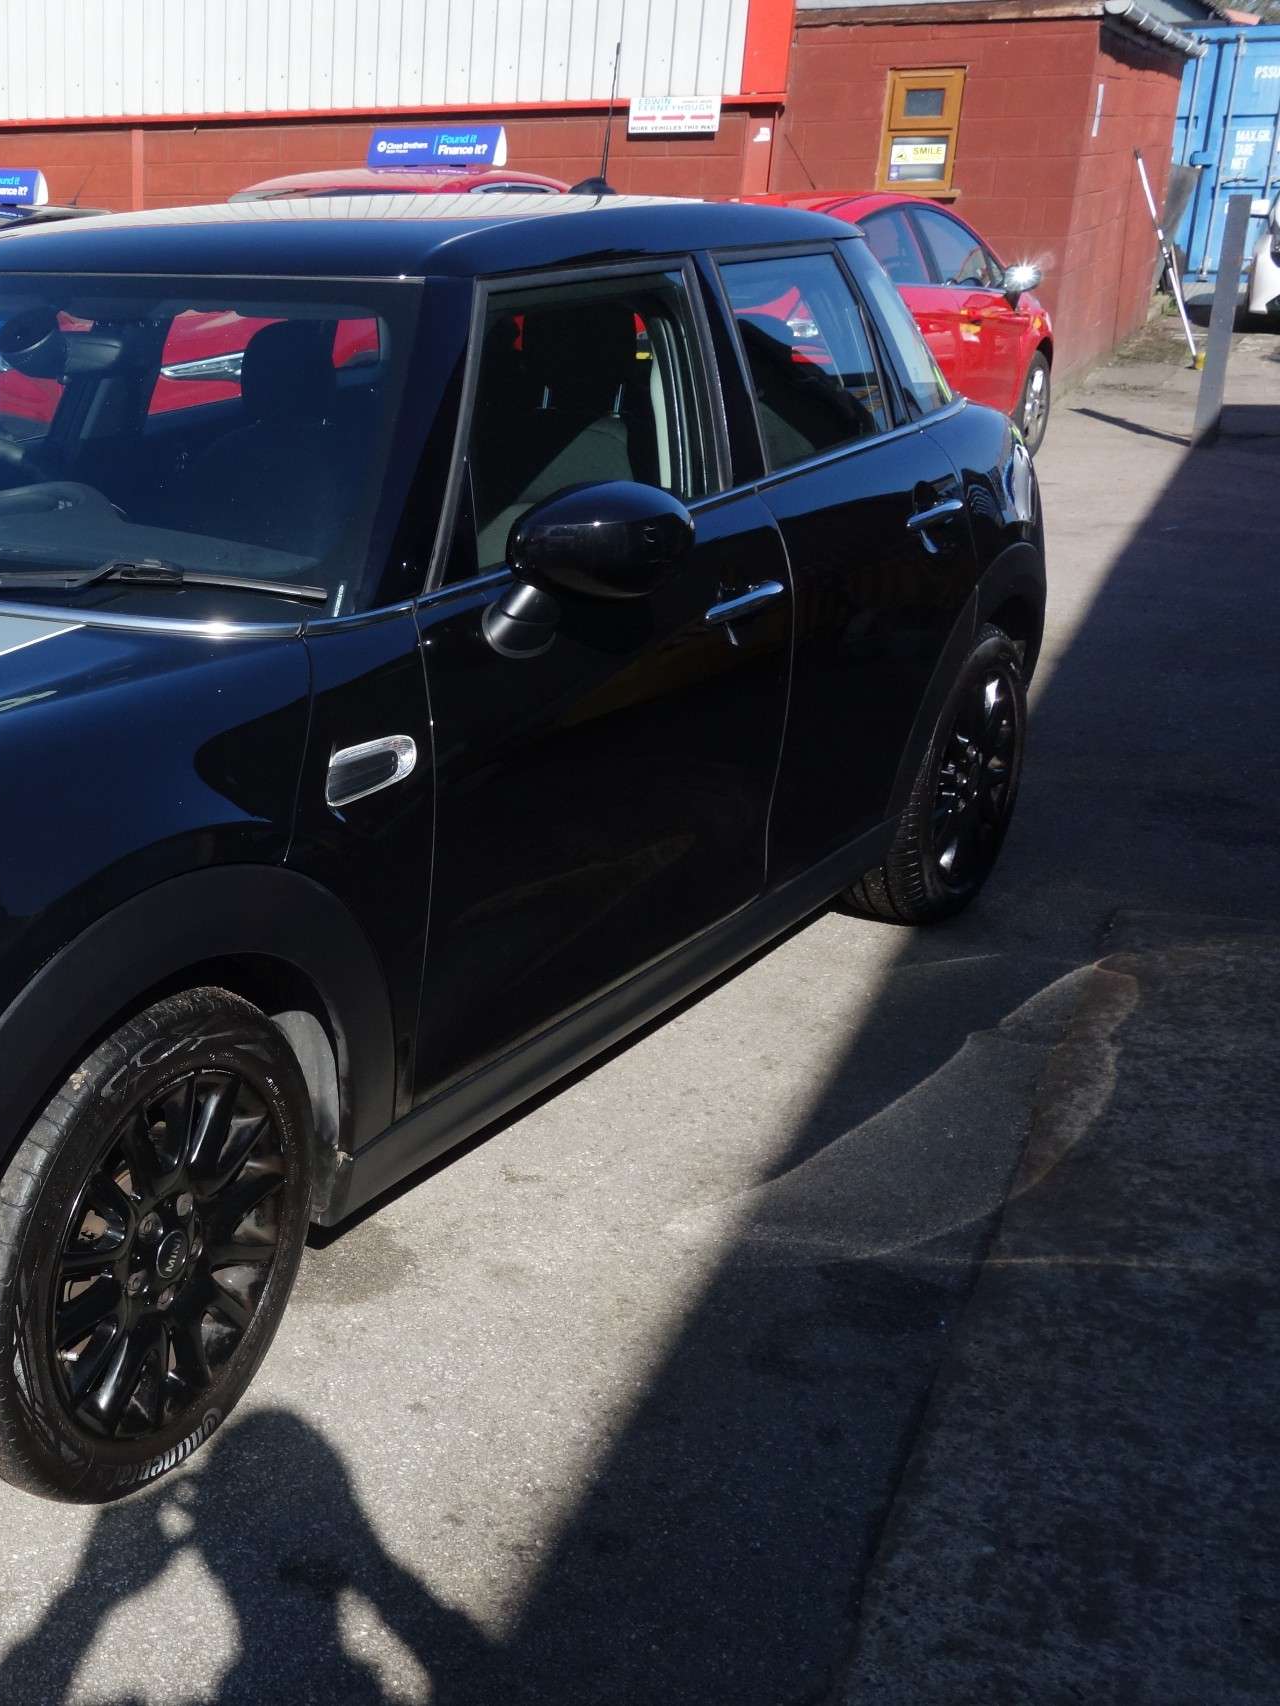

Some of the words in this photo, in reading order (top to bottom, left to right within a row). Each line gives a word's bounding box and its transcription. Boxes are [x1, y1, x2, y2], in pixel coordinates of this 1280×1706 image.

[638, 104, 712, 112] FERNEYHOUGH
[439, 135, 470, 144] Found
[471, 134, 479, 144] it
[438, 144, 474, 155] Finance
[474, 143, 489, 155] it?
[913, 146, 943, 156] SMILE
[1230, 157, 1249, 170] NET
[17, 186, 29, 196] it?
[165, 1238, 182, 1272] MINI
